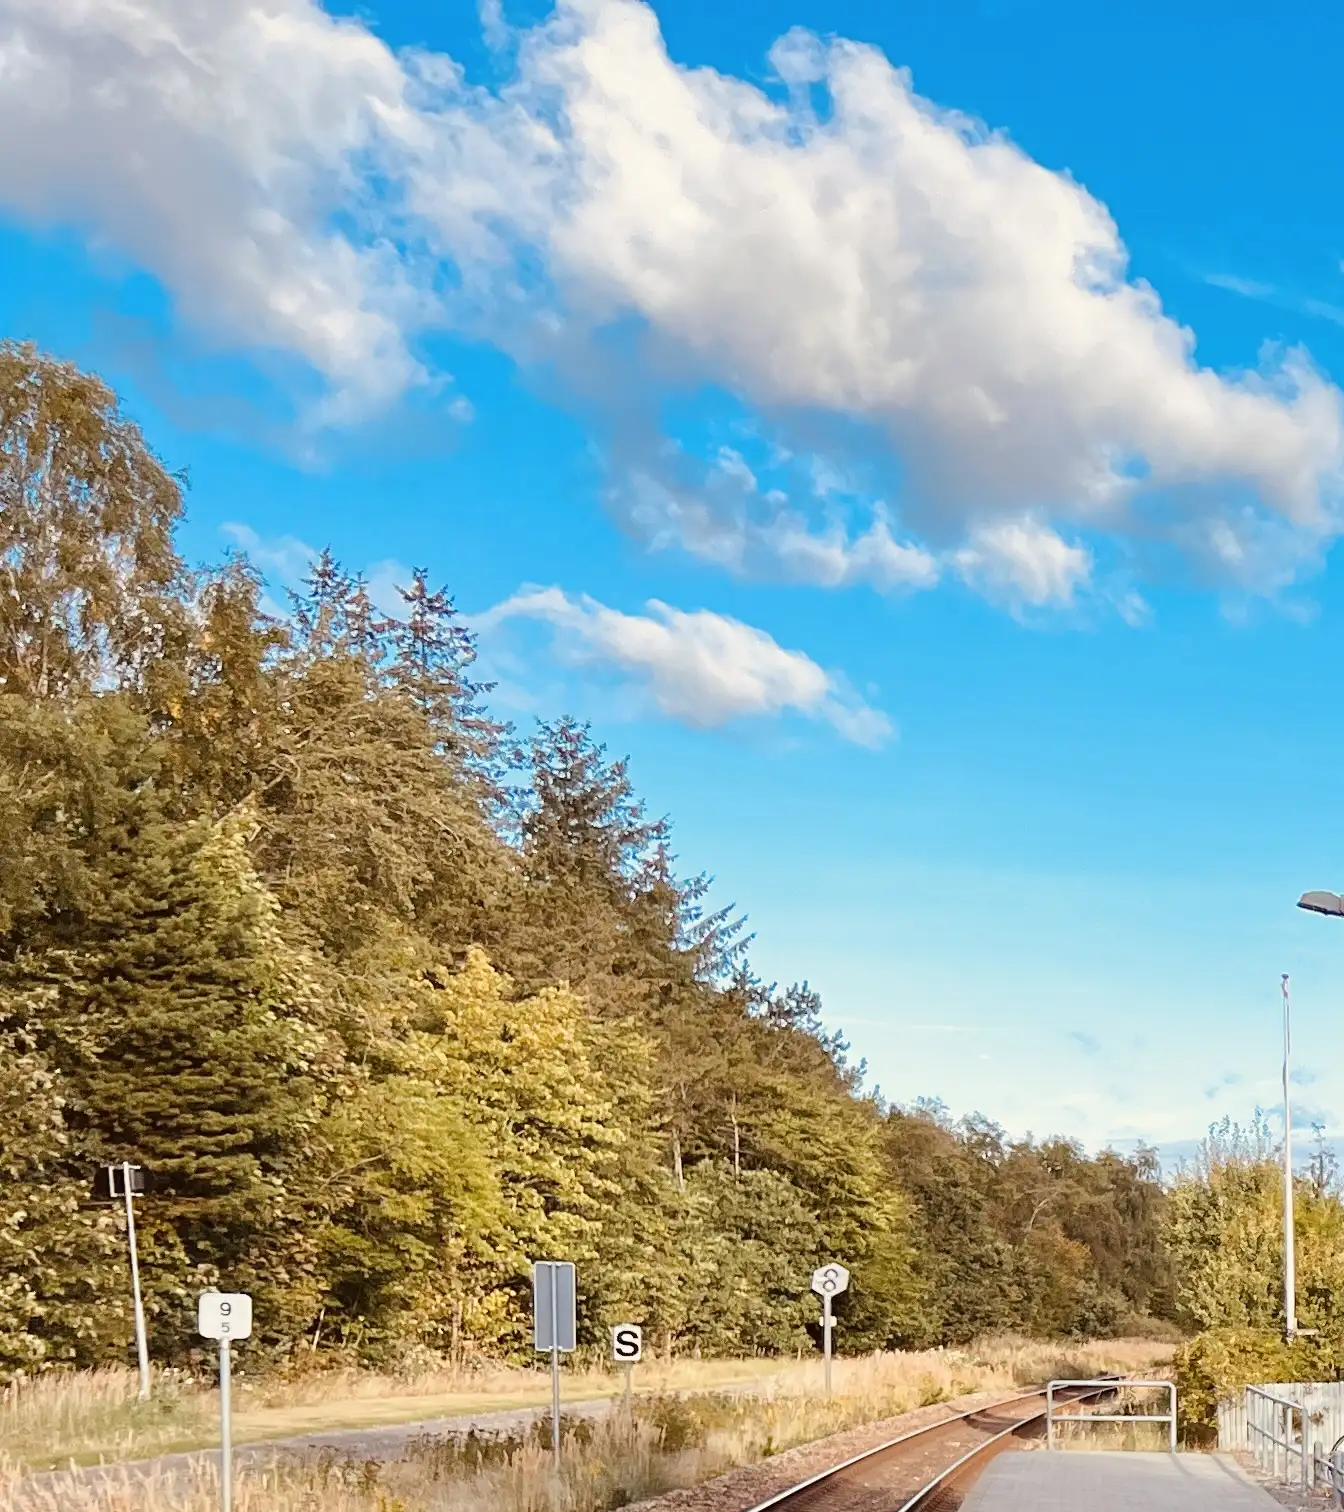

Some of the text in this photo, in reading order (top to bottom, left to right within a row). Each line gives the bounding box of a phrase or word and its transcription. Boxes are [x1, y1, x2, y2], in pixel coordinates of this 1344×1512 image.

[220, 1302, 231, 1316] 9
[221, 1321, 230, 1333] 5
[616, 1330, 639, 1357] S
